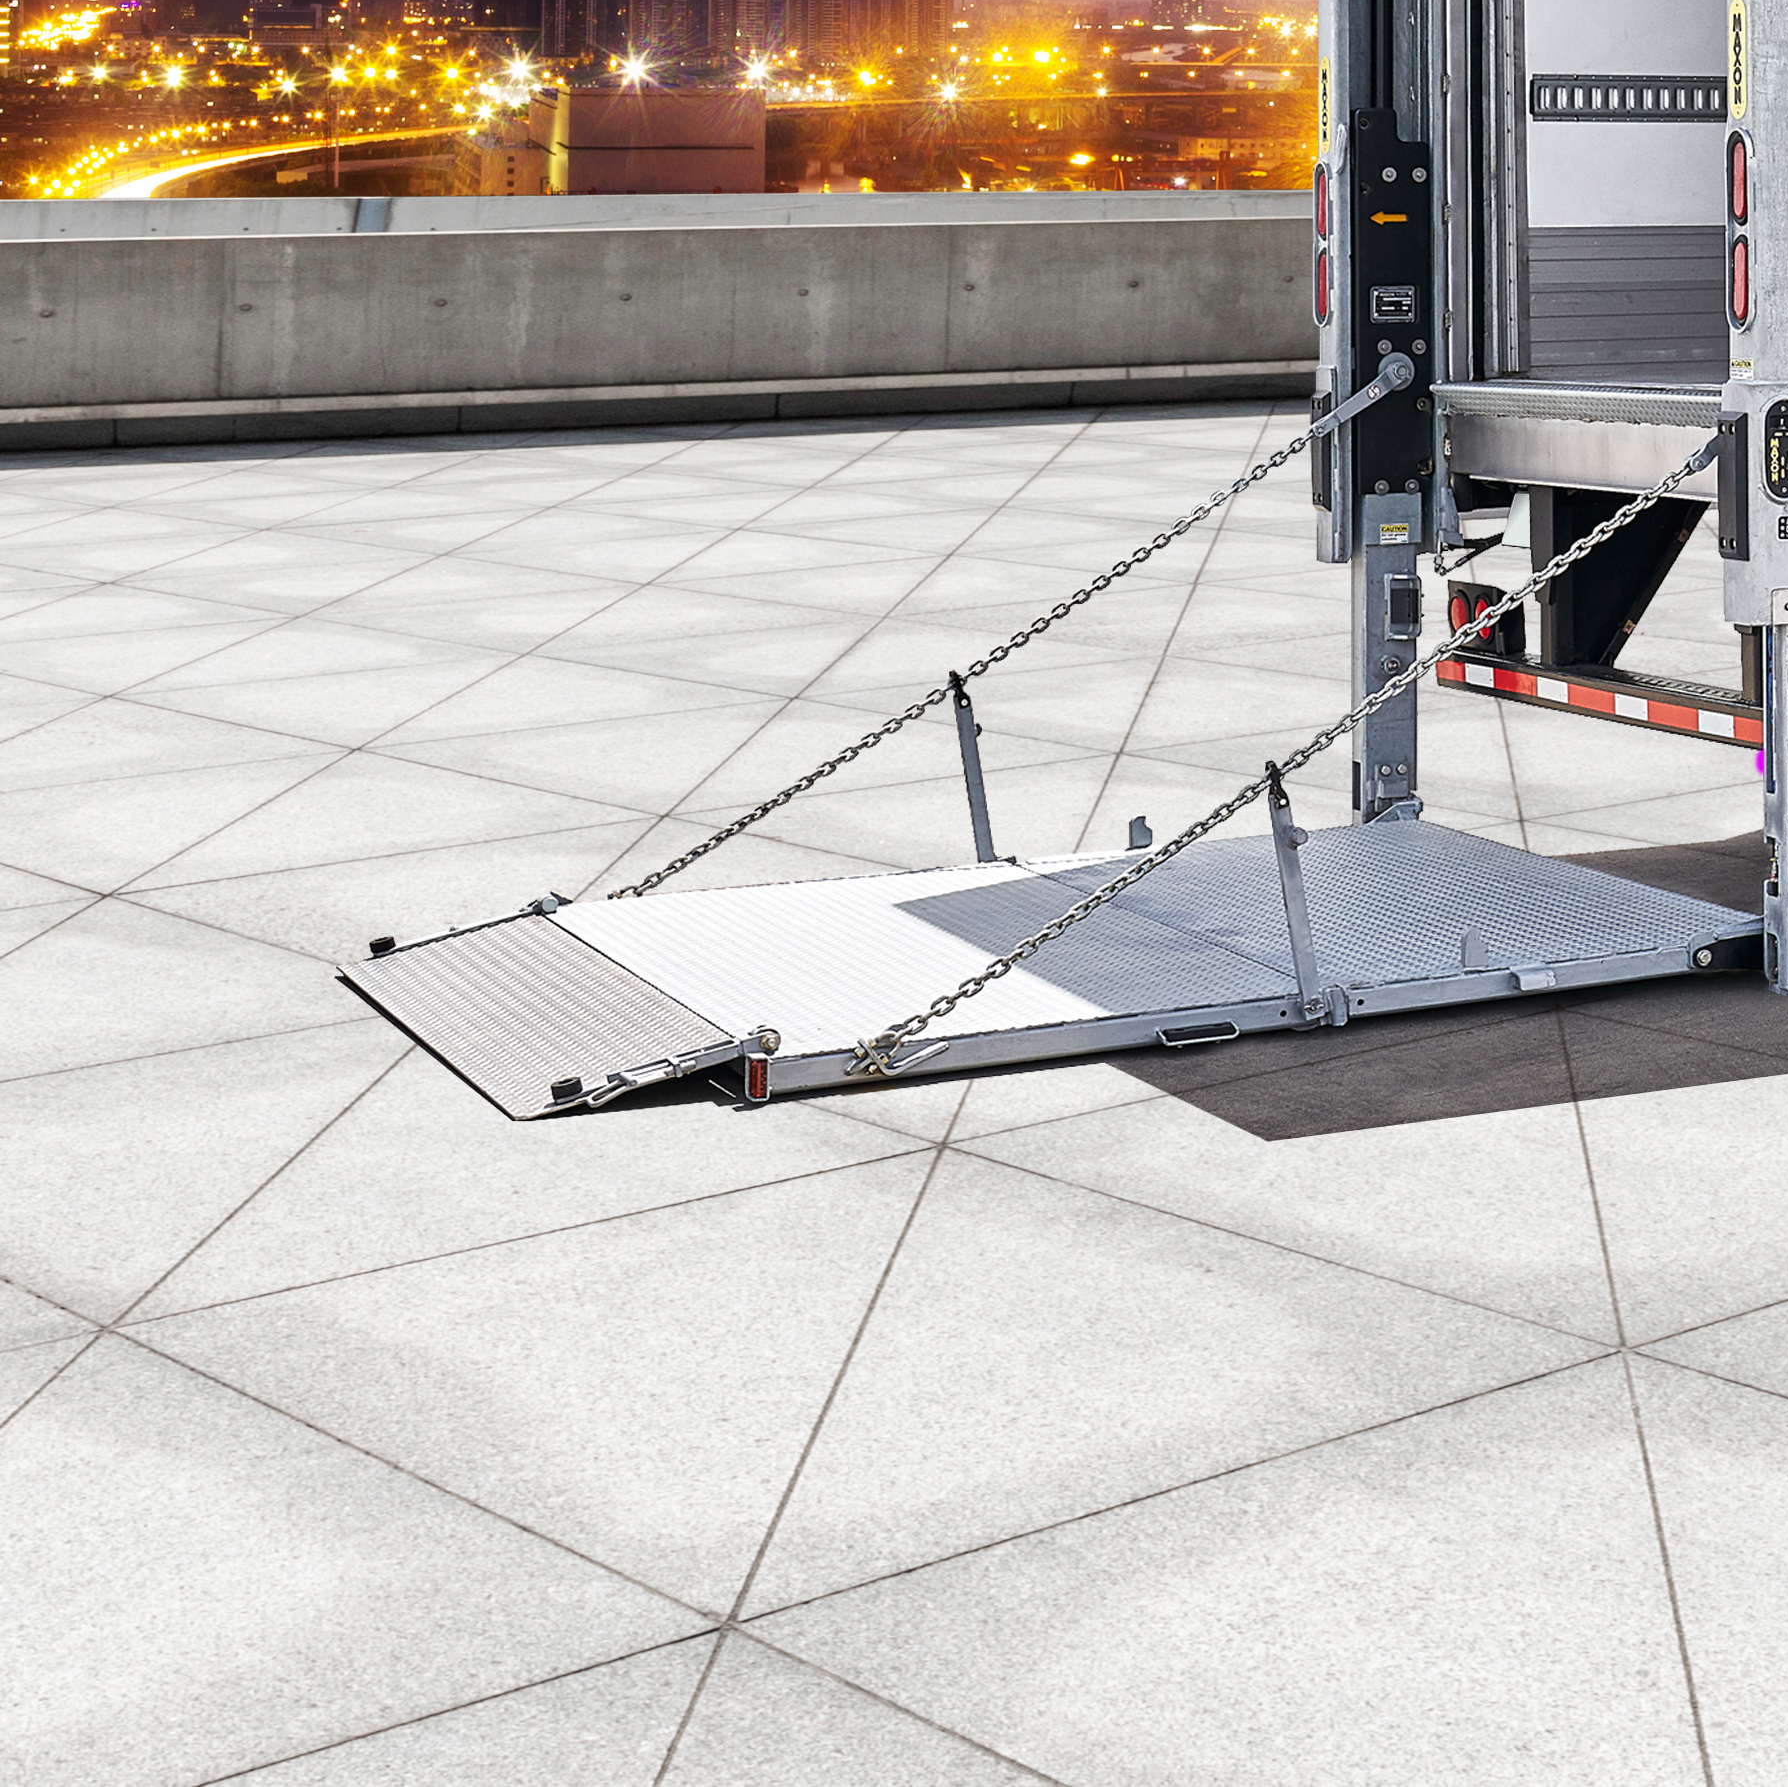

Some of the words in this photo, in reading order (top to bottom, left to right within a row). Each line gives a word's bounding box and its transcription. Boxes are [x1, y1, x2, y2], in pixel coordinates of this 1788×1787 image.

[1732, 13, 1742, 105] MAXON
[1321, 68, 1329, 143] MAXON
[1769, 438, 1779, 482] MAXON
